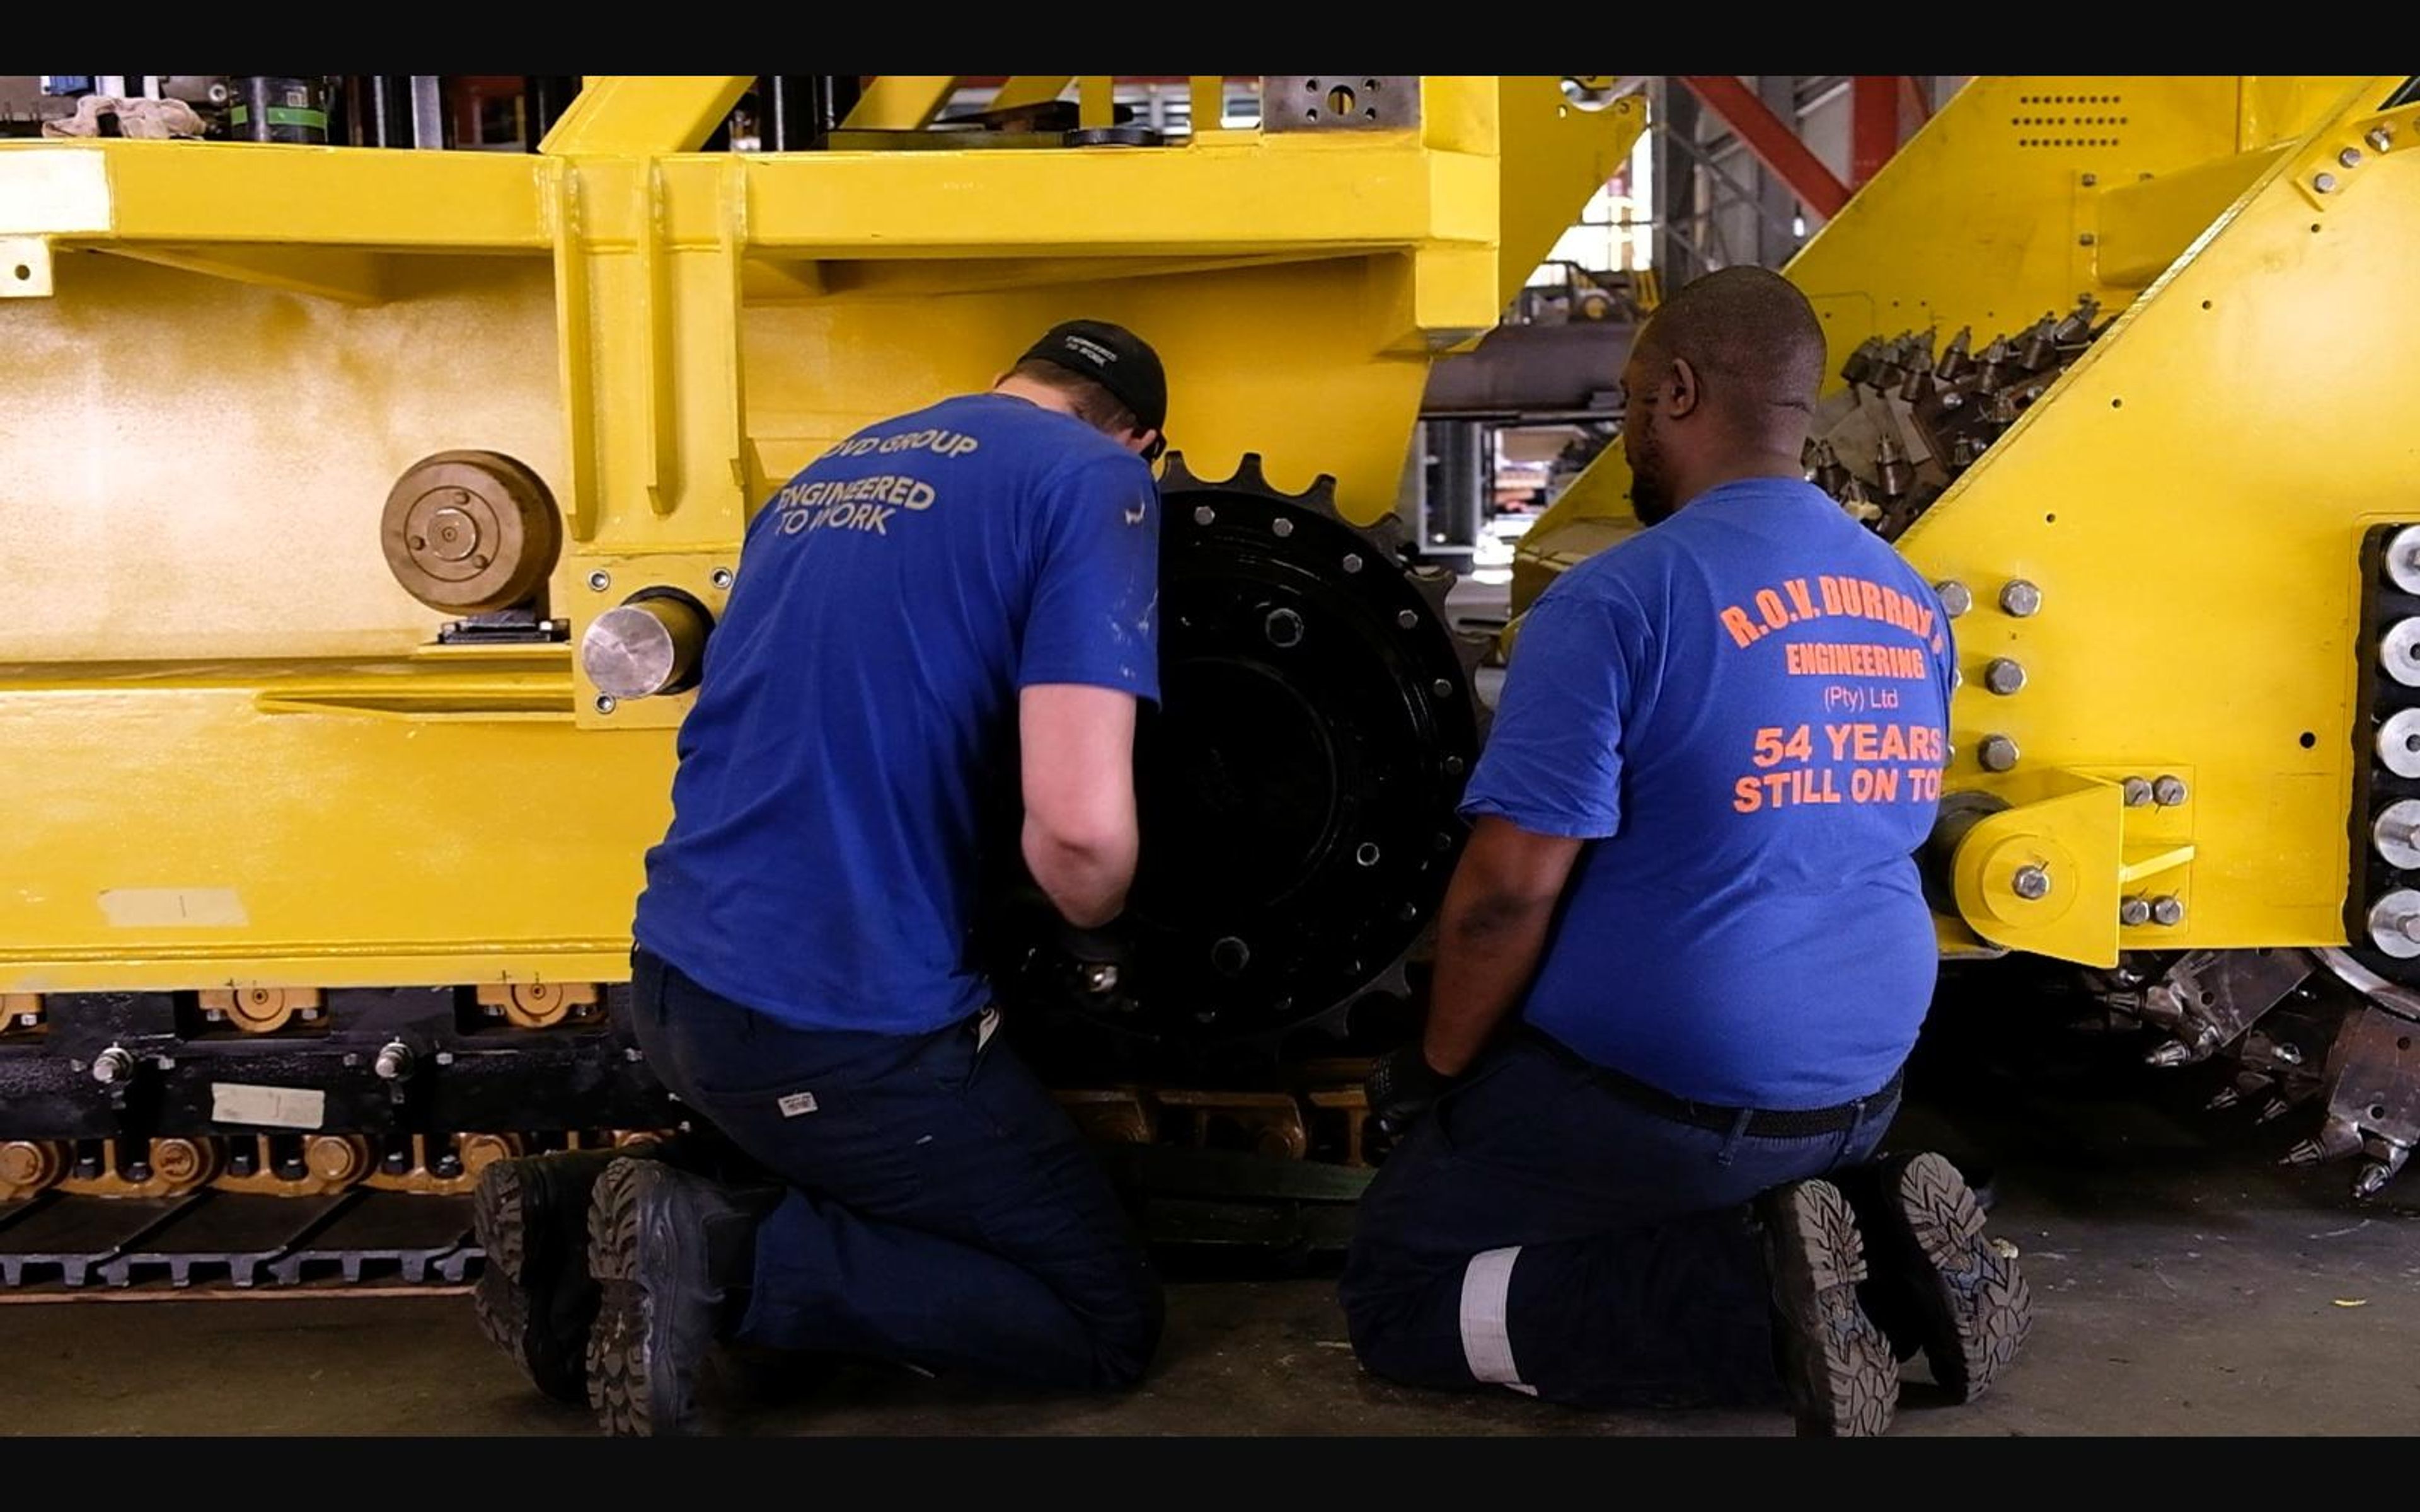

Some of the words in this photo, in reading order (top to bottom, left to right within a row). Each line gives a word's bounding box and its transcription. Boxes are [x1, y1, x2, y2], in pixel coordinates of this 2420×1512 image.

[879, 429, 978, 458] GROUP
[775, 476, 936, 513] ENGINEERED
[775, 509, 809, 536] TO
[809, 504, 896, 535] WORK
[1720, 578, 1820, 649] R.O.V.
[1785, 643, 1926, 679] ENGINEERING
[1824, 686, 1865, 711] (Pty)
[1870, 687, 1899, 709] Ltd
[1753, 725, 1812, 767] 54
[1824, 724, 1942, 762] YEARS
[1734, 769, 1841, 813] STILL
[1851, 768, 1899, 803] ON
